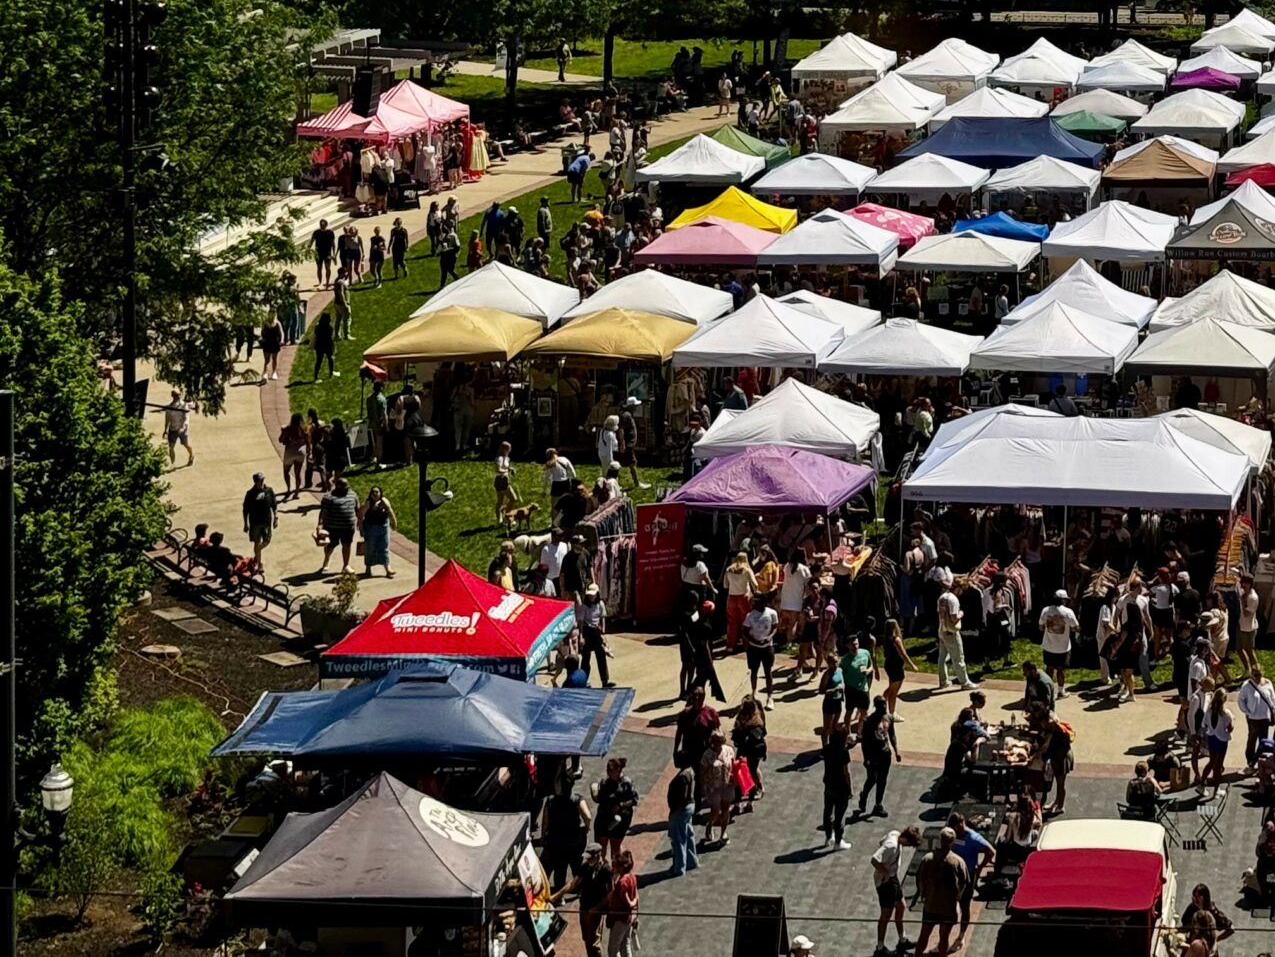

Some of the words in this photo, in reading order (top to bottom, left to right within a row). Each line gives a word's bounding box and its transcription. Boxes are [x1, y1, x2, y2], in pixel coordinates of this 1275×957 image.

[1166, 248, 1195, 258] Willow
[1199, 248, 1215, 258] Run
[1217, 248, 1248, 258] Custom
[390, 611, 481, 635] Tweedles!
